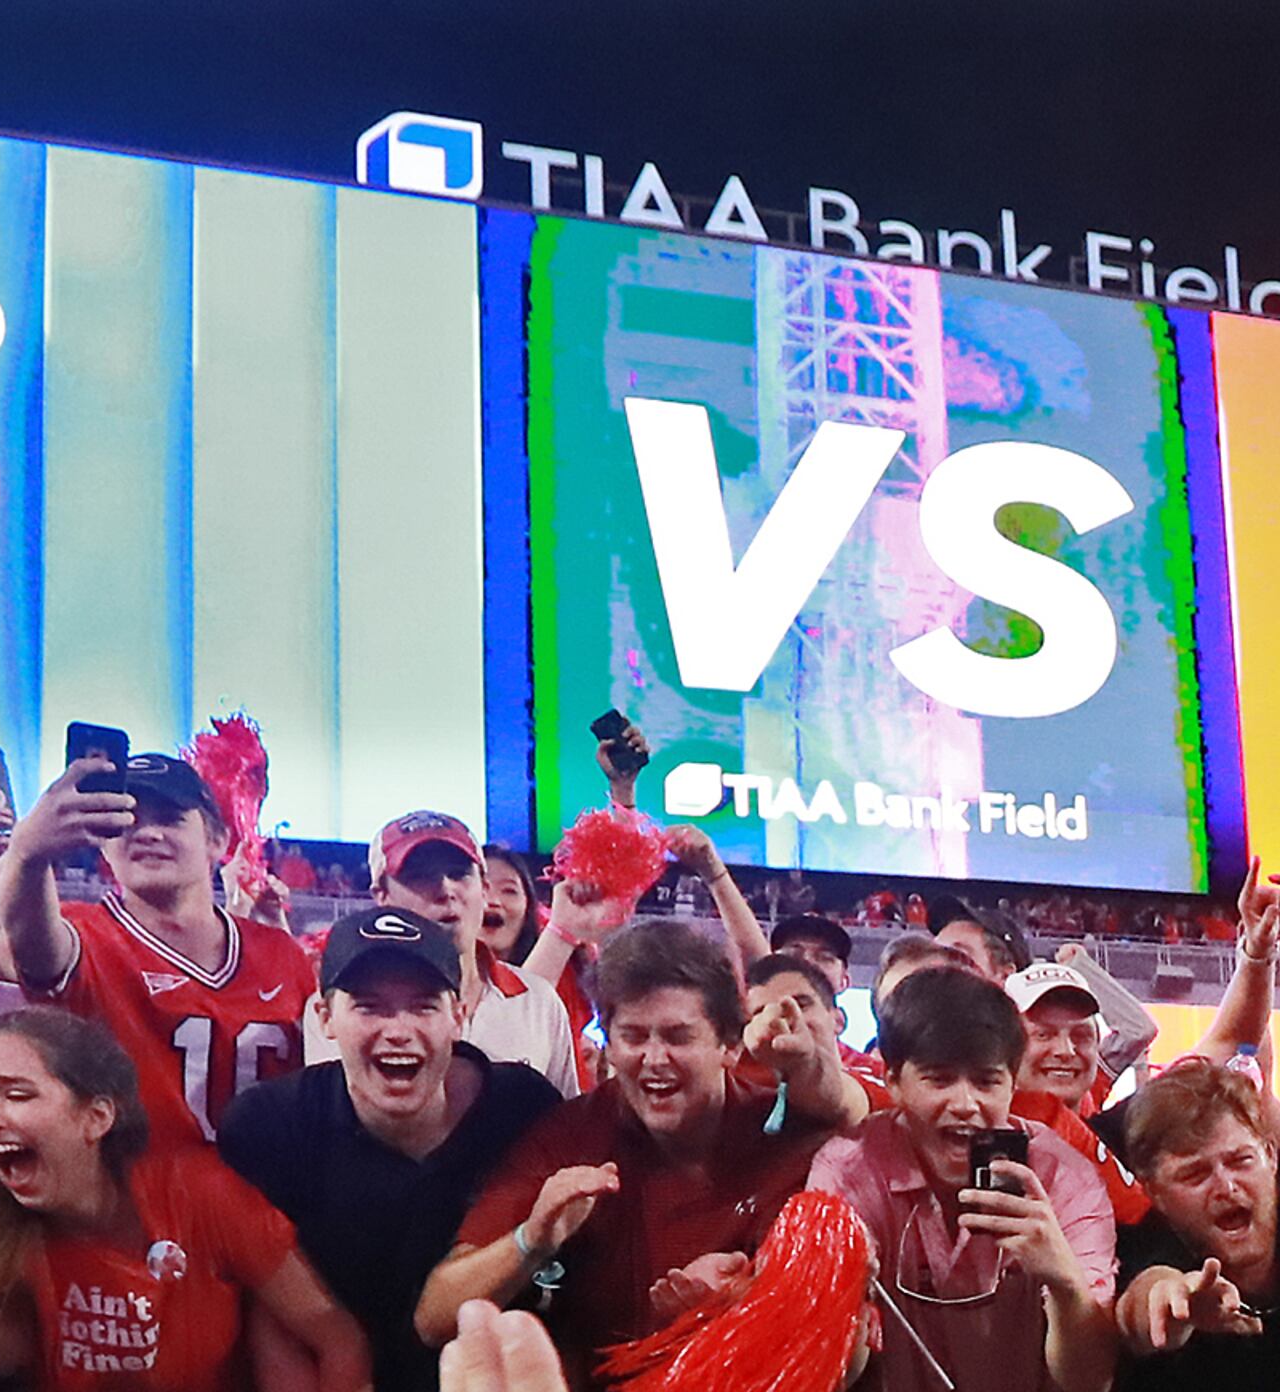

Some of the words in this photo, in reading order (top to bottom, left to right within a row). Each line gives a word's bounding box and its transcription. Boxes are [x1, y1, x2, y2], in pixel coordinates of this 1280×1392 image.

[501, 141, 770, 241] TIAA
[808, 186, 1053, 282] Bank
[622, 396, 1136, 719] VS
[721, 772, 848, 826] TIAA
[853, 781, 971, 833] Bank
[978, 791, 1089, 841] Field
[1024, 968, 1078, 983] UGA
[63, 1281, 153, 1321] Ain't
